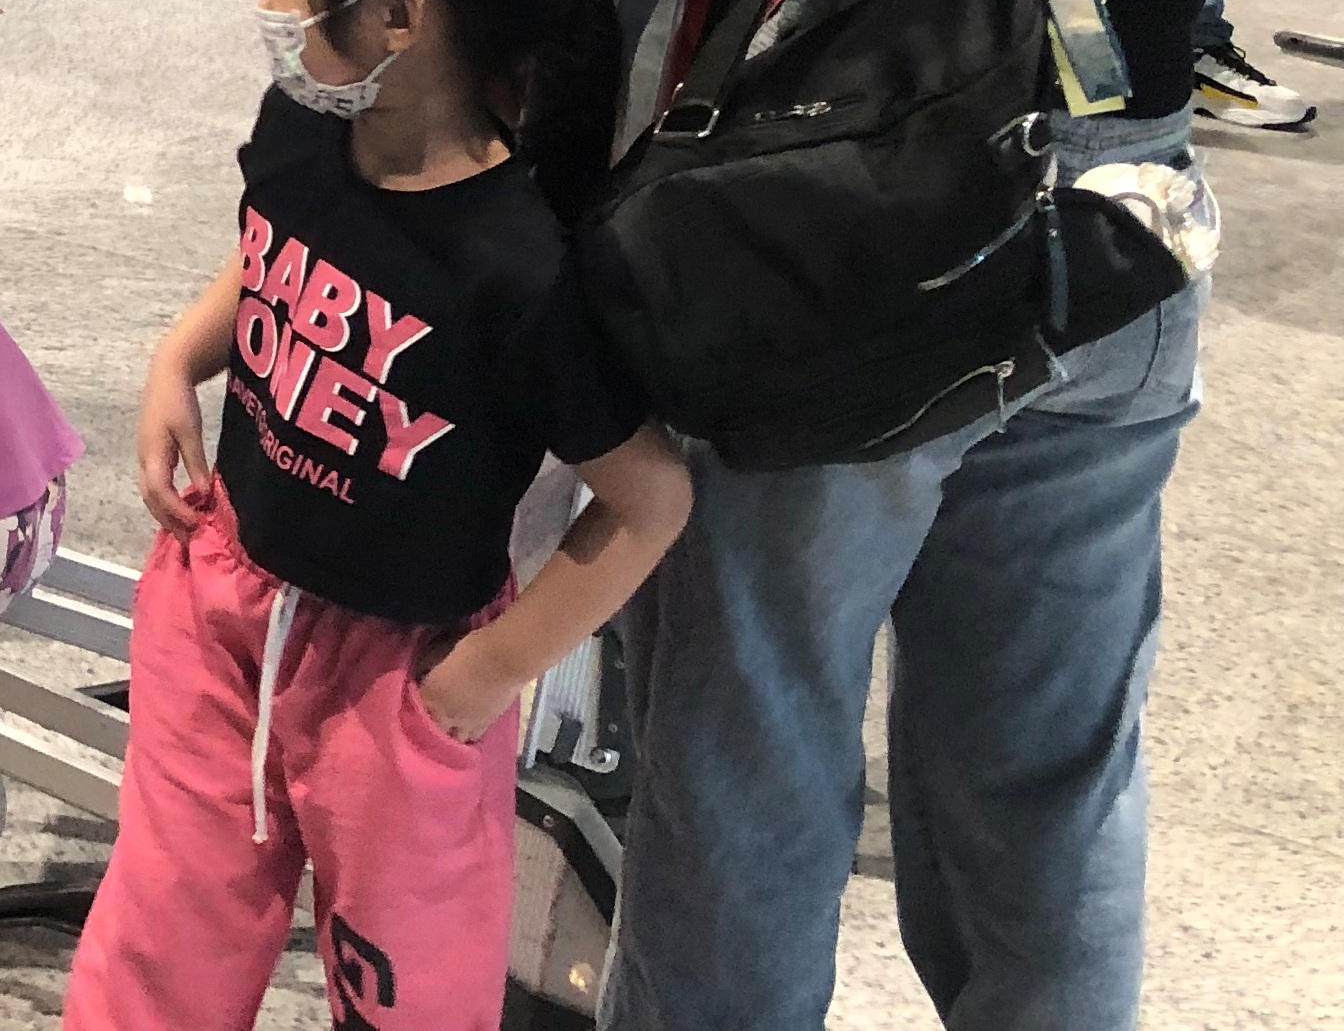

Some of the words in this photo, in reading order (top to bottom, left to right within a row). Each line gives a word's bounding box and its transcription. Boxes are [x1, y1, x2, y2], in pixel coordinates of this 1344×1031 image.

[240, 206, 433, 385] BABY
[236, 296, 456, 481] ONEY
[259, 427, 355, 505] RIGINAL
